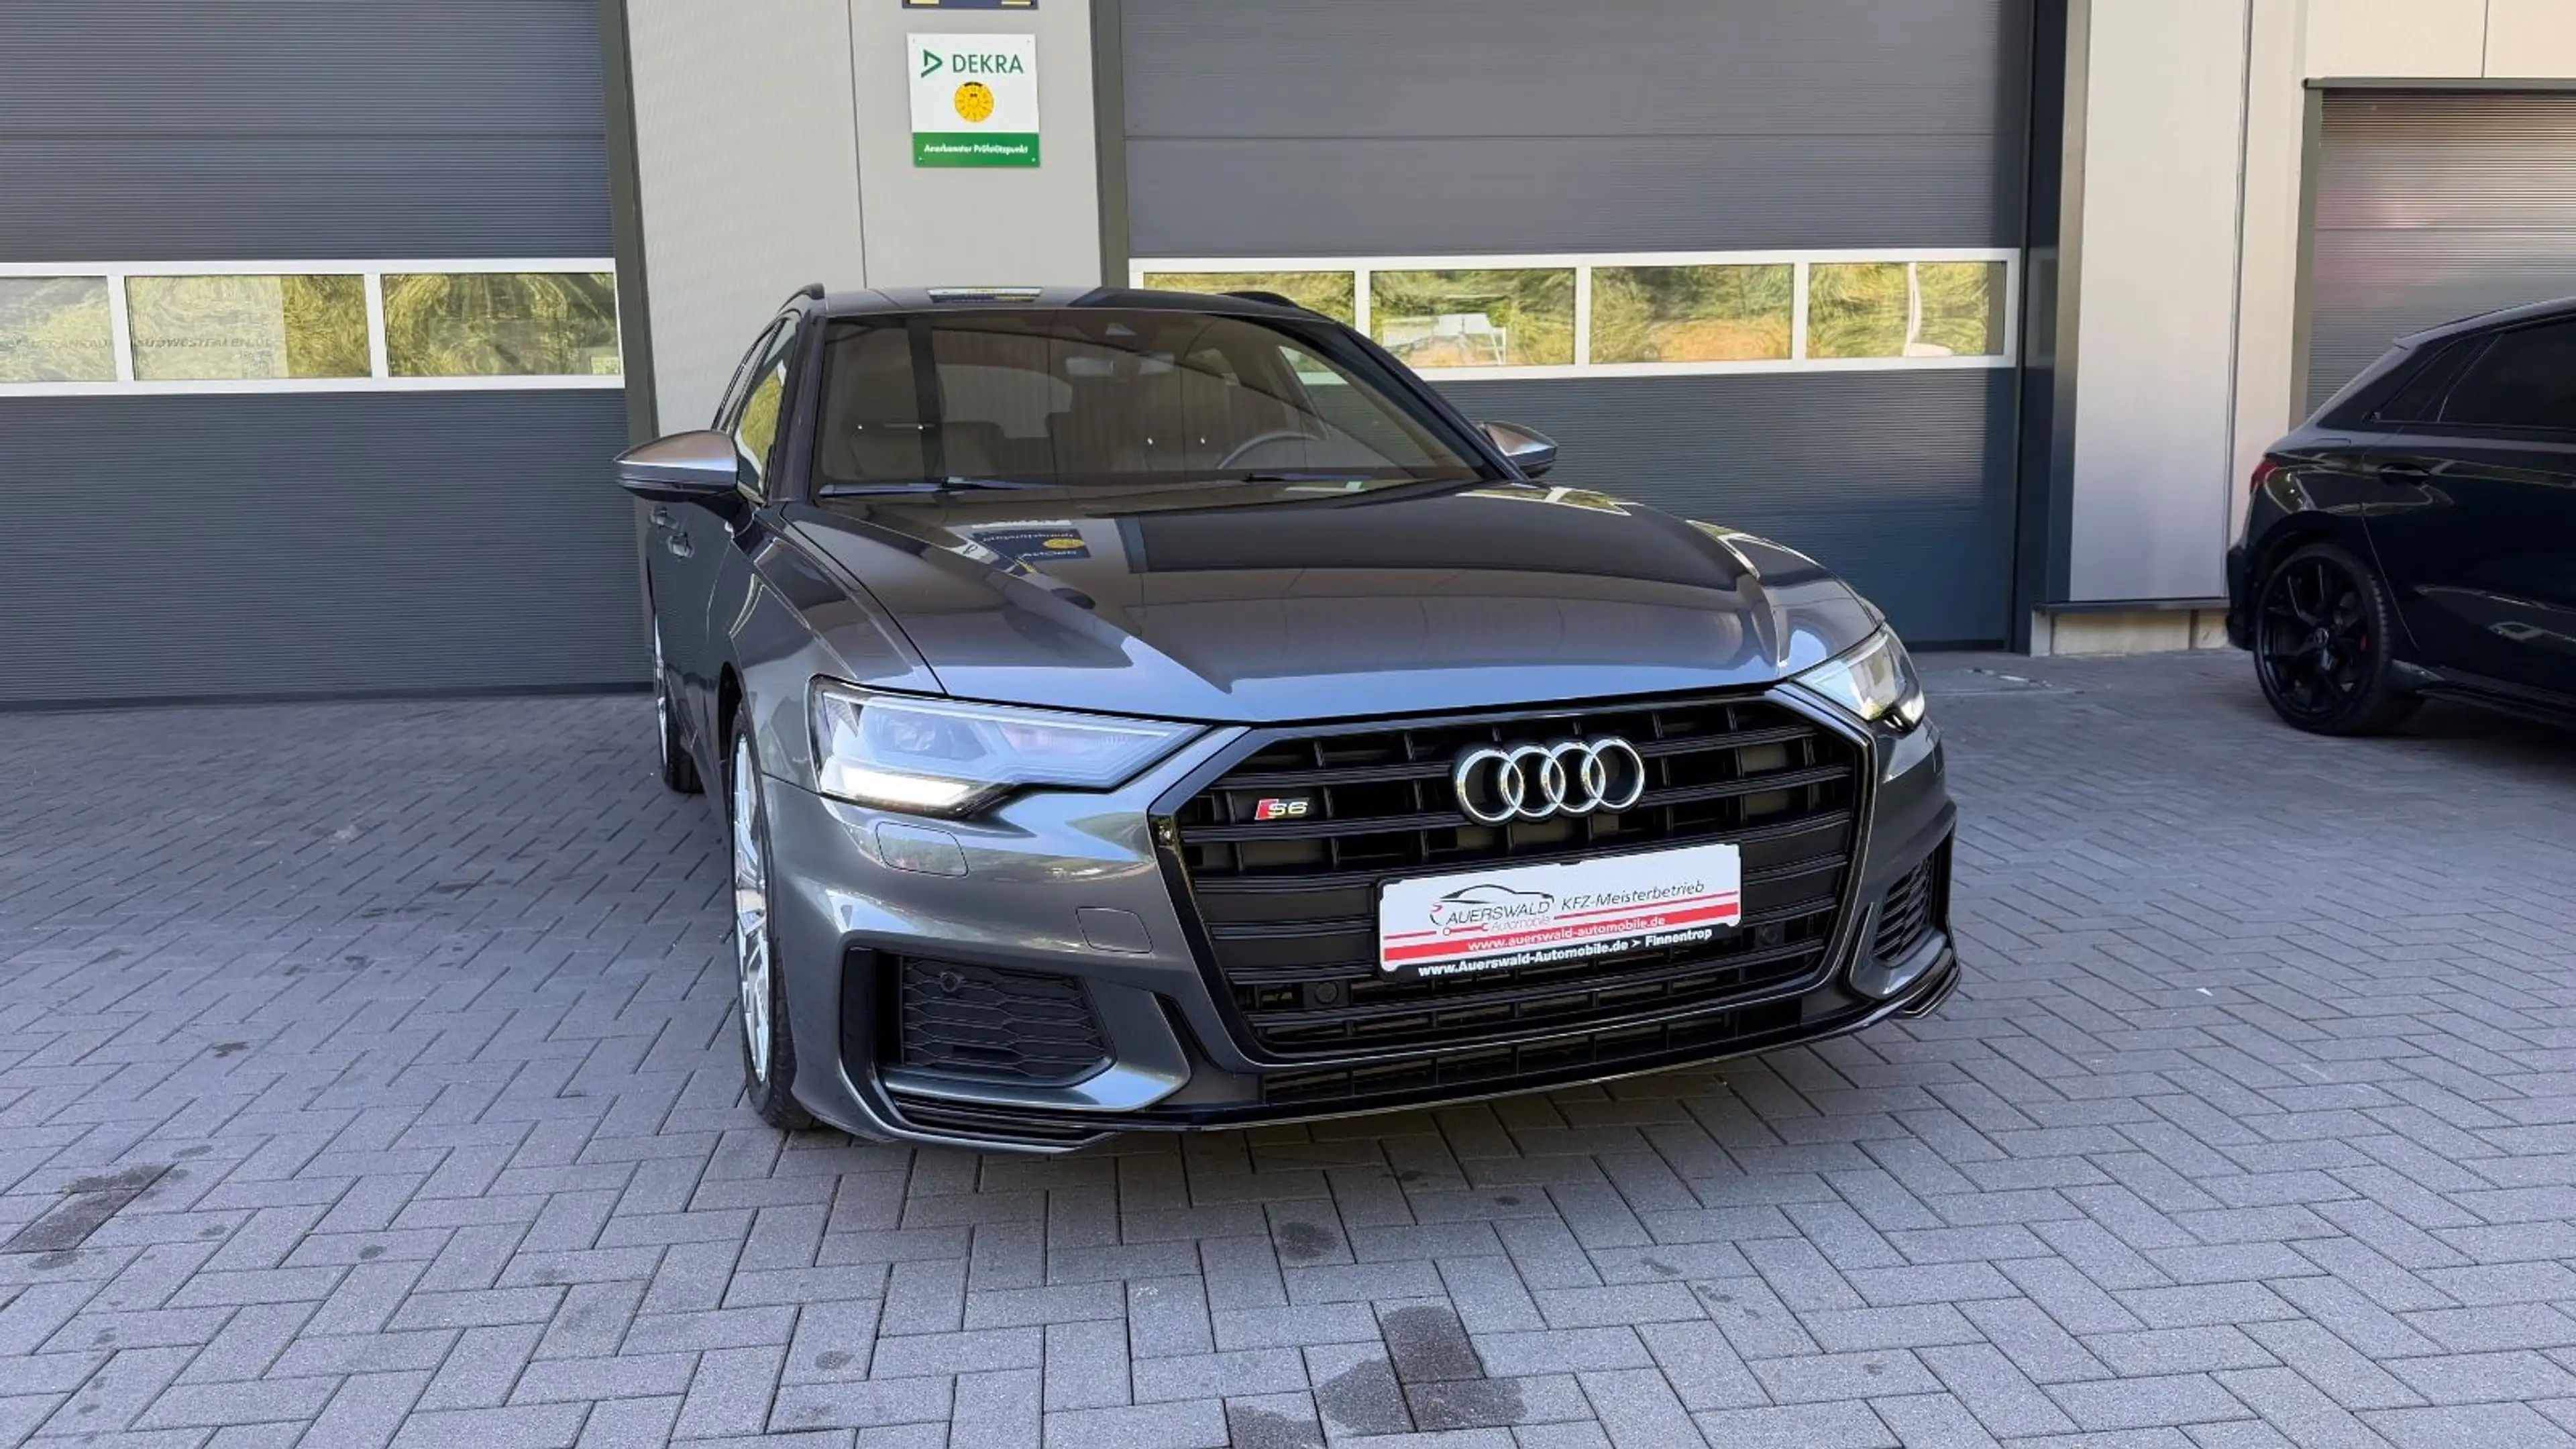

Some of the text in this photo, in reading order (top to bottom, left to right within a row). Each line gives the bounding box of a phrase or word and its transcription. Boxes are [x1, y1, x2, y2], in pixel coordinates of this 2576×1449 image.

[952, 54, 1024, 74] DEKRA
[1268, 801, 1308, 816] S6
[1446, 880, 1705, 925] AUERSWALD KFZ-Meisterbetrieb
[1468, 916, 1666, 951] www.auerswald-automobile.de
[1417, 928, 1713, 977] www.Auerswald-Automobile.de Finnentrop
